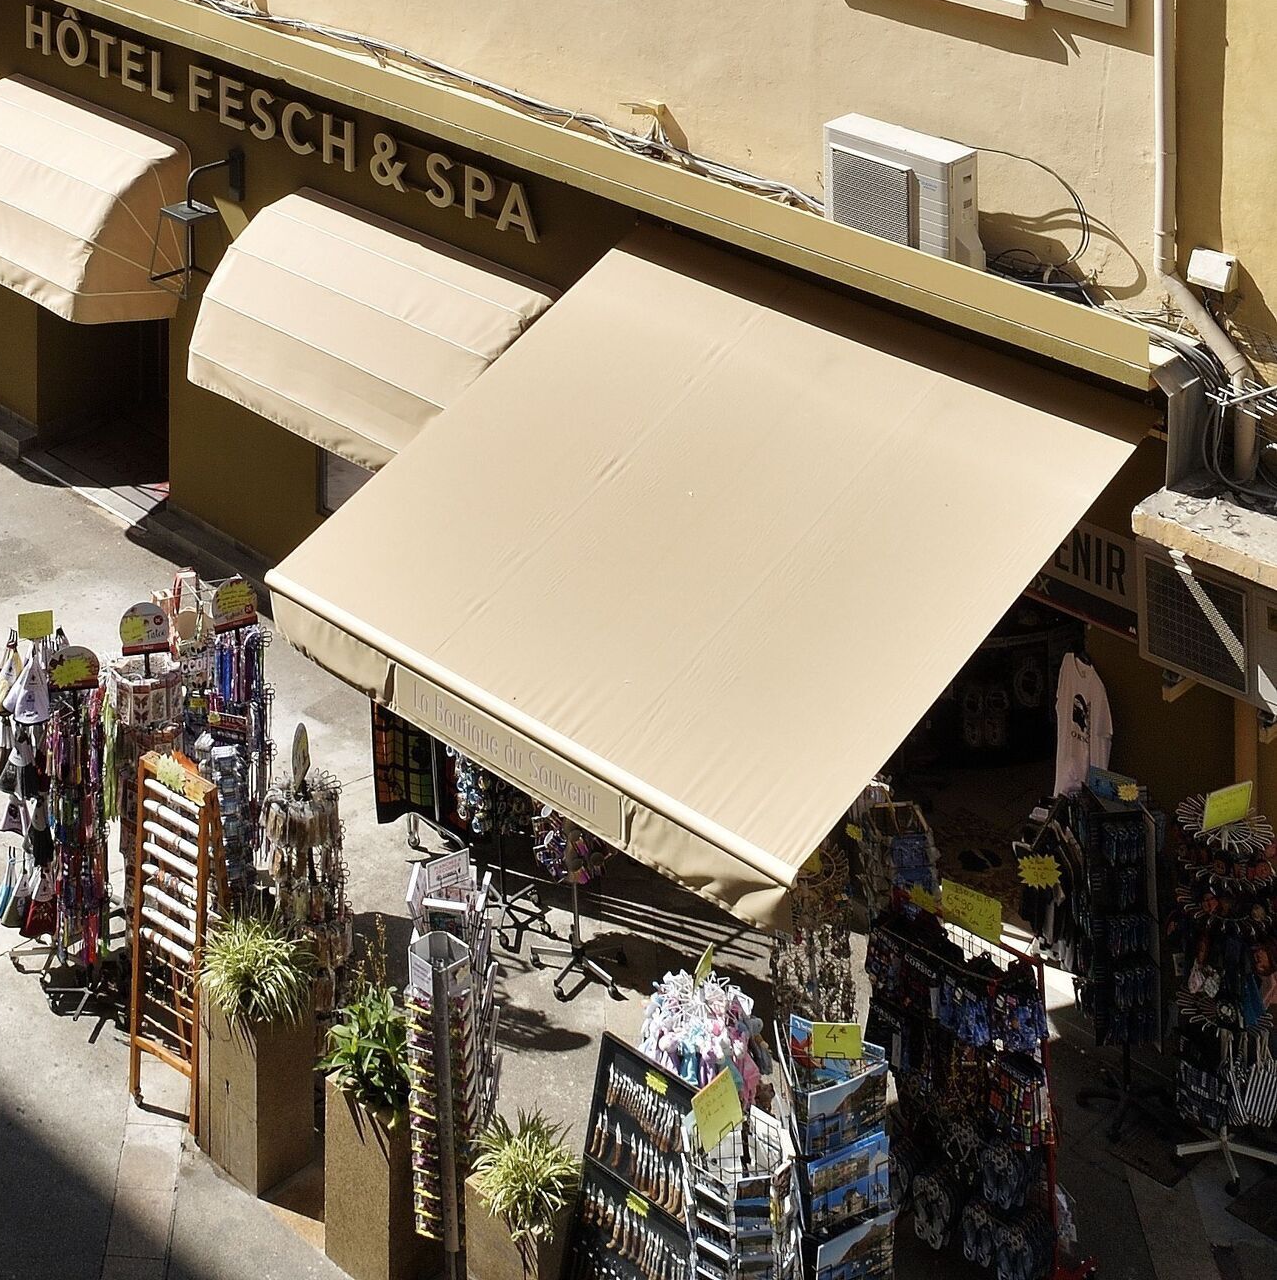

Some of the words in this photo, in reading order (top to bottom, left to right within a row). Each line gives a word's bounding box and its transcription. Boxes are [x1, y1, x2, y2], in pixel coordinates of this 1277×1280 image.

[25, 6, 175, 103] HÔTEL
[188, 64, 358, 173] FESCH
[369, 132, 409, 193] &
[425, 152, 541, 244] SPA
[435, 693, 499, 757] Boutique
[504, 737, 523, 771] du
[529, 750, 599, 816] Souvenir
[904, 952, 937, 979] CORSICA
